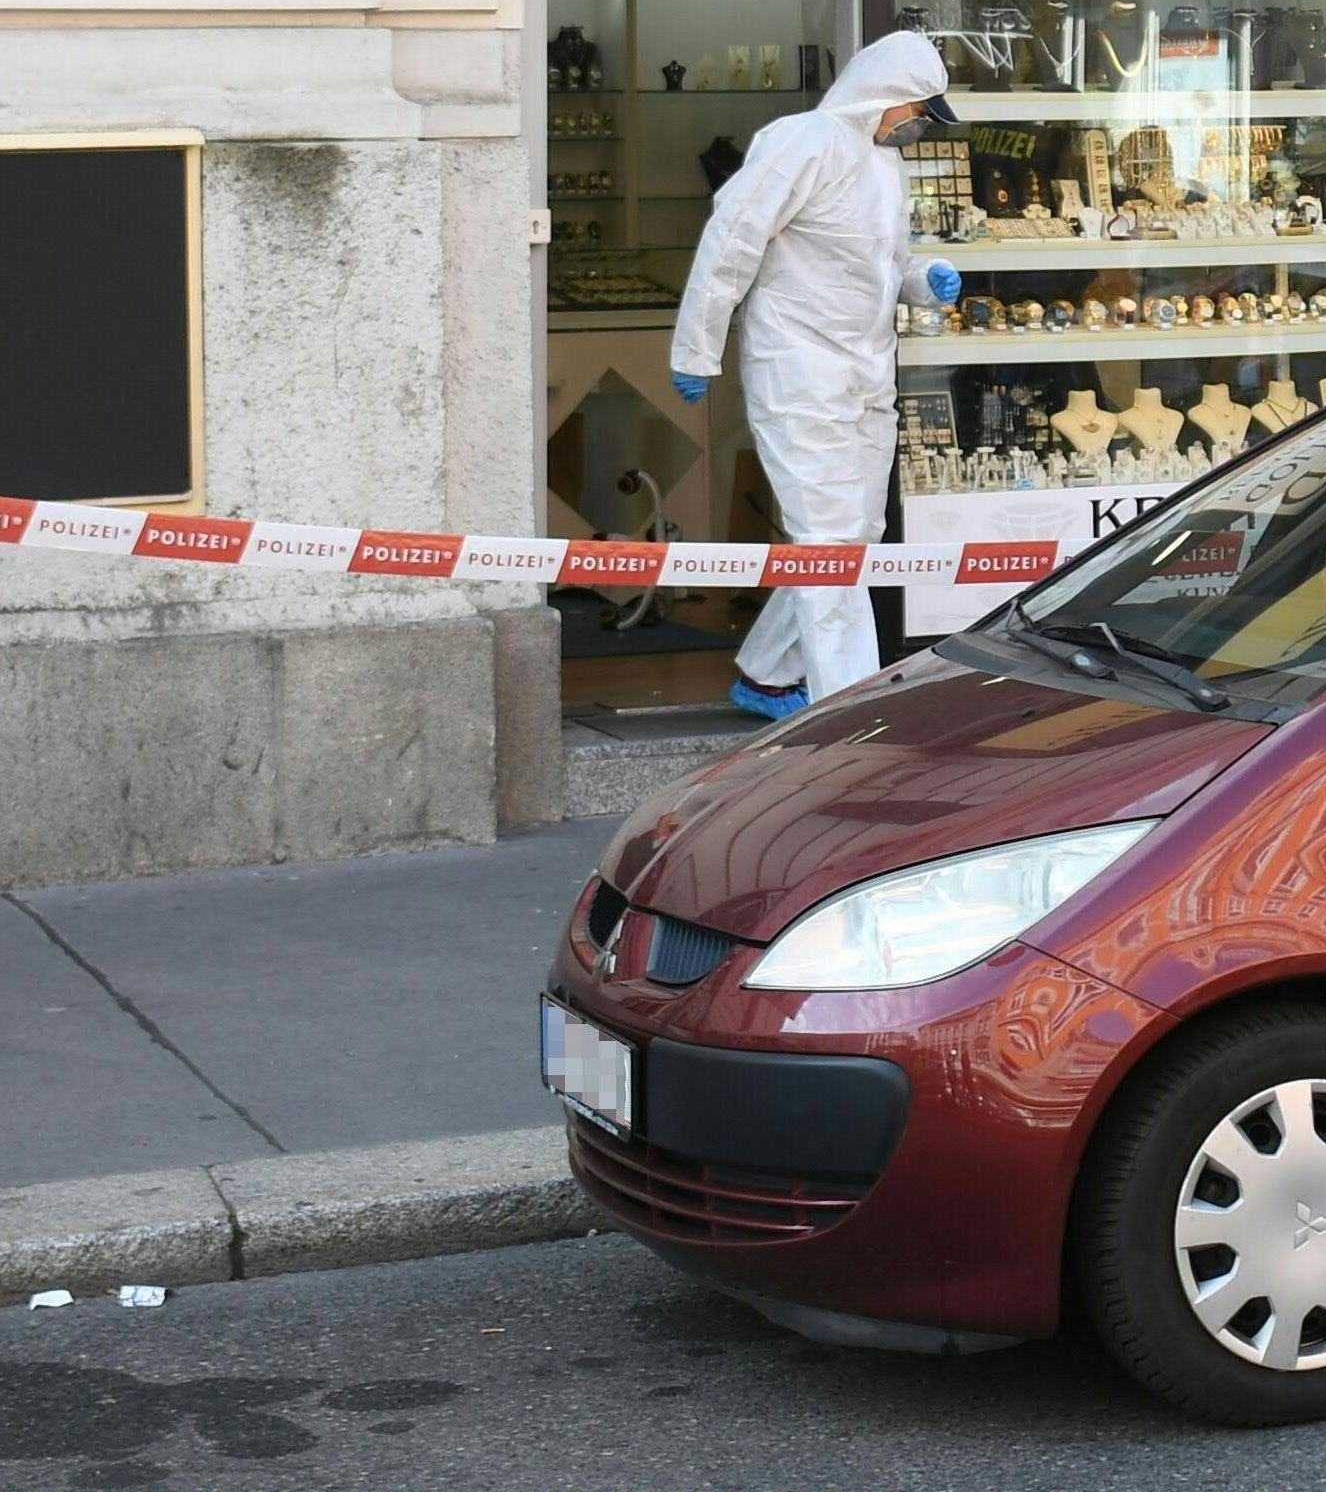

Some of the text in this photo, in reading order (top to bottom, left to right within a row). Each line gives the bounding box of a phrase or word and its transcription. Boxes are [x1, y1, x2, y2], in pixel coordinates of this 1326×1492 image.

[39, 519, 1039, 574] POLIZEI POLIZEI POLIZEI POLIZEI POLIZEI POLIZEI POLIZEI POLIZEI POLIZEI POLIZEI
